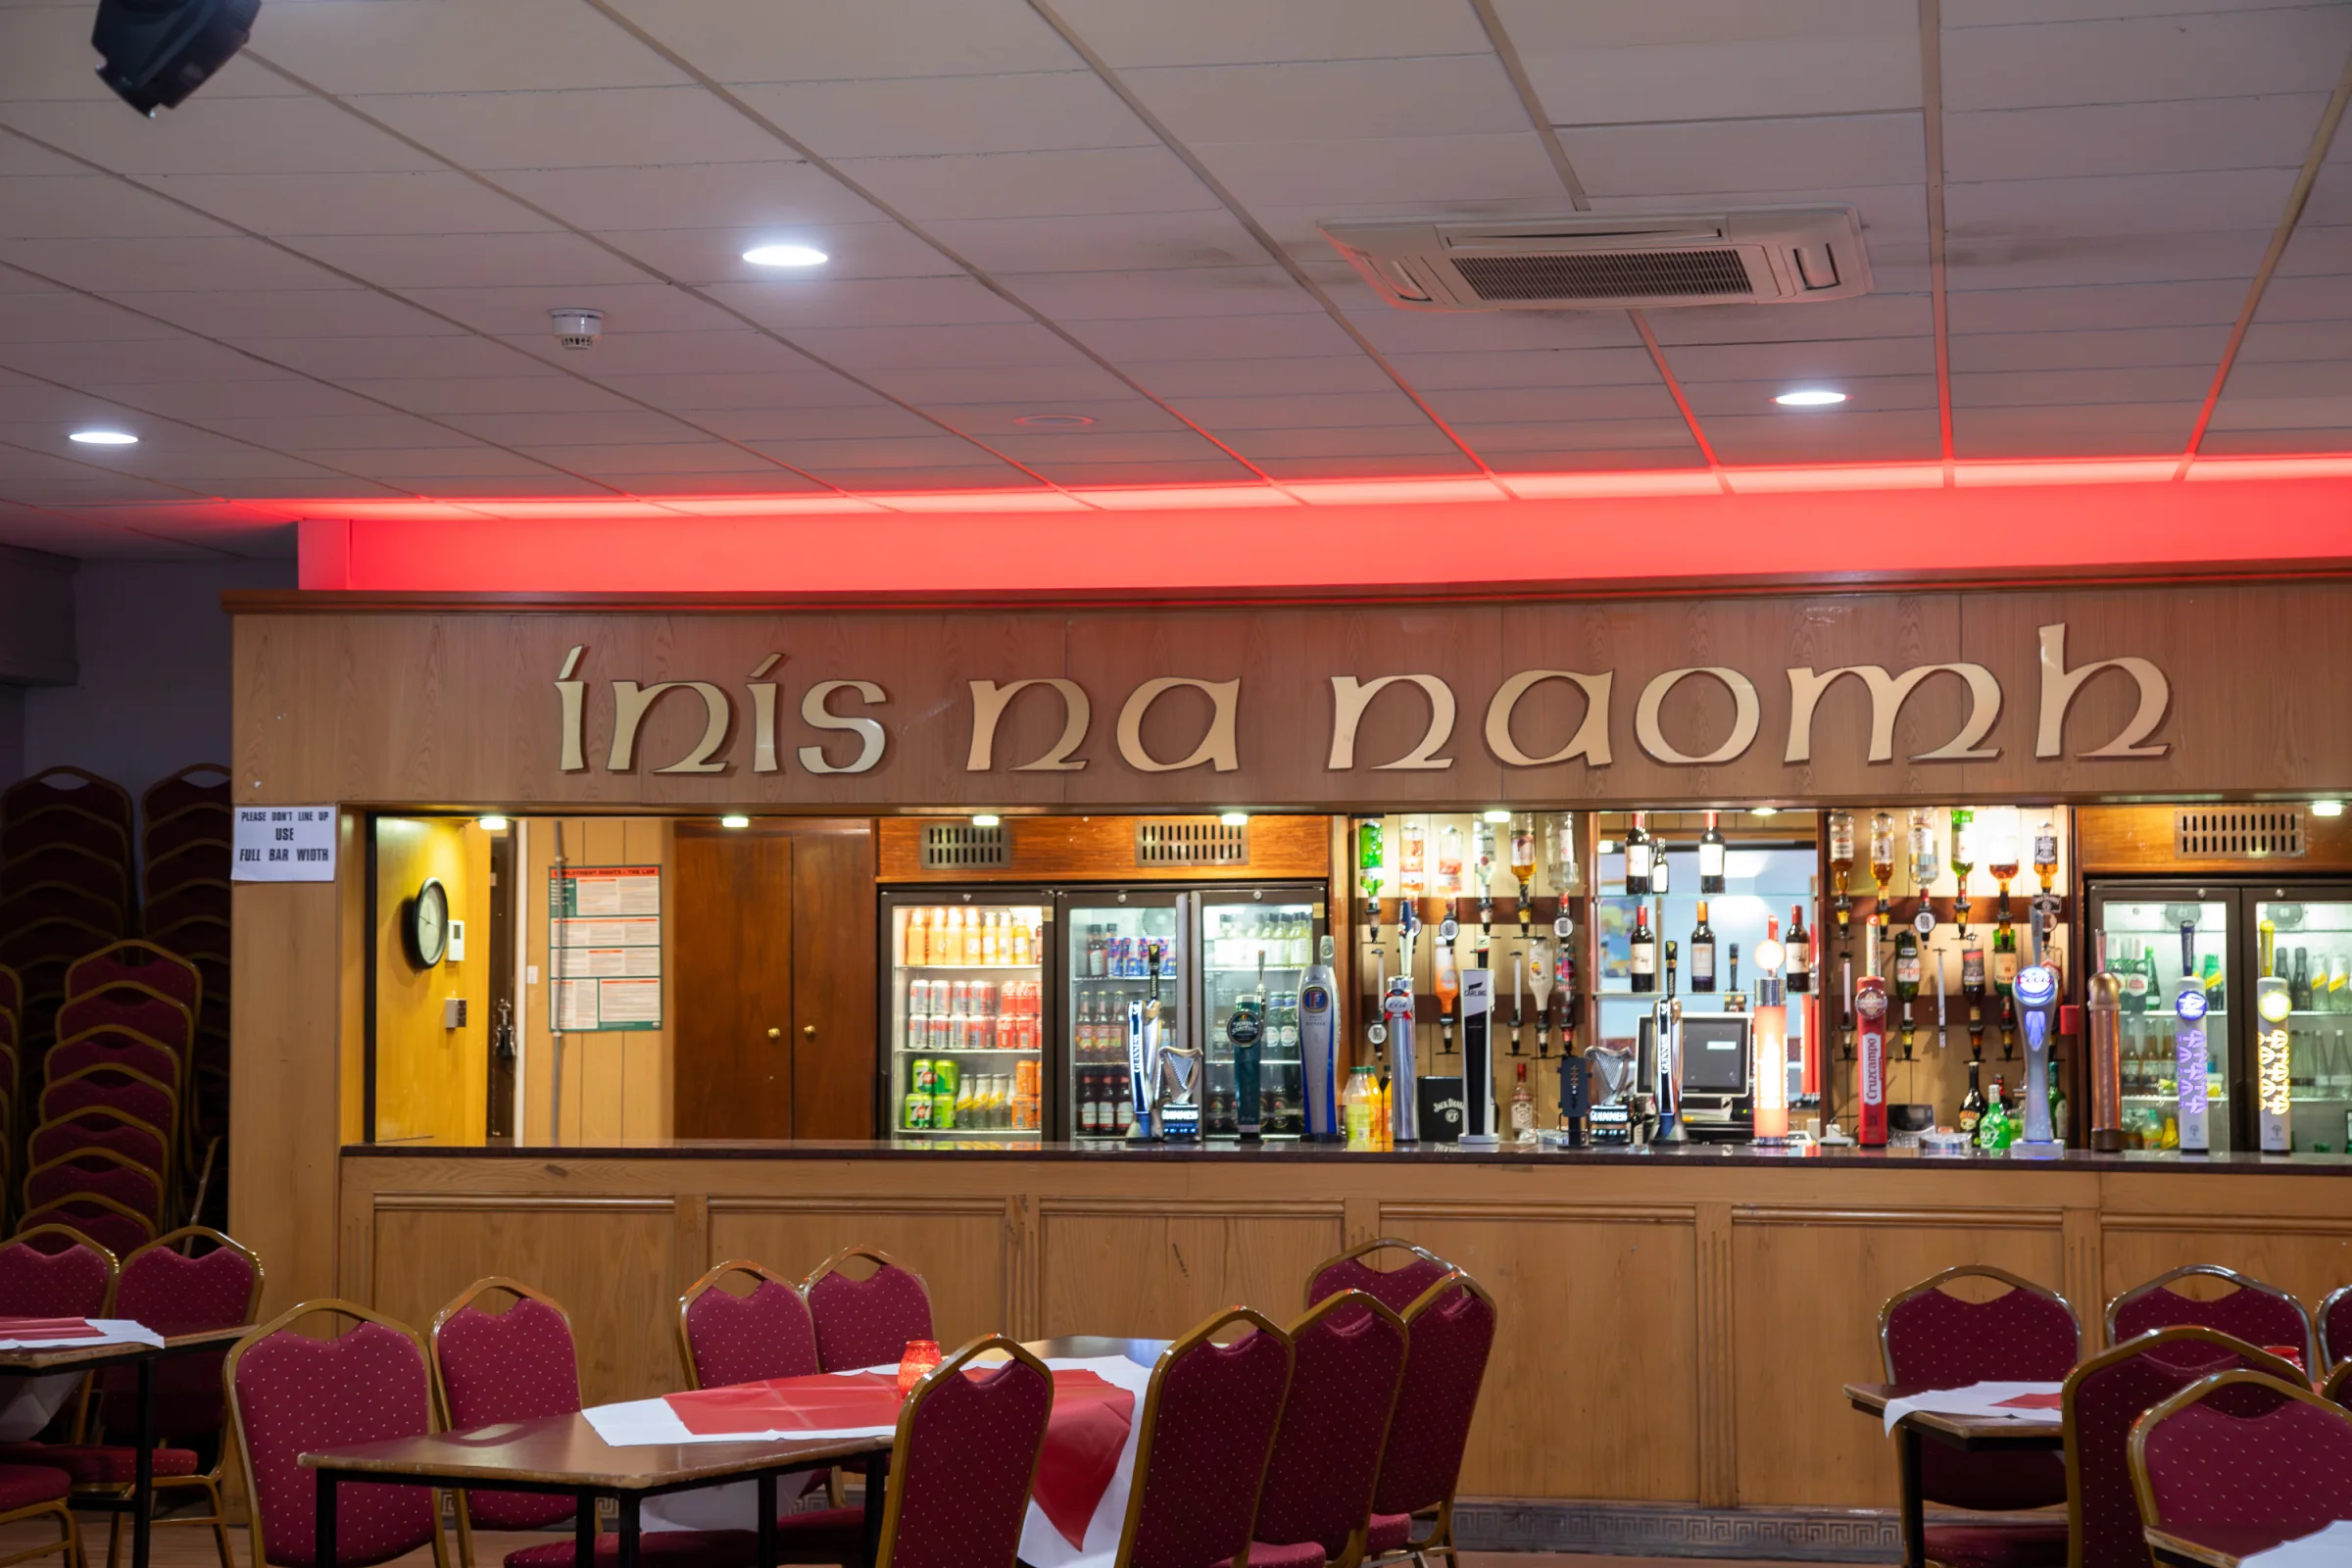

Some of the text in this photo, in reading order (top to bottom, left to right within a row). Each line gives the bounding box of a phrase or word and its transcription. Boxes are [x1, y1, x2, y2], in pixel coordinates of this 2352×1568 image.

[964, 675, 1242, 773] na
[1327, 622, 2173, 770] naomh
[241, 811, 329, 821] PLEASE DON'T LINE UP
[275, 828, 294, 841] USE
[239, 849, 328, 861] FULL BAR WIDTH
[1660, 1034, 1669, 1074] GUINNESS
[1866, 1037, 1879, 1100] Cruzcampo
[1590, 1109, 1628, 1122] GUINNESS
